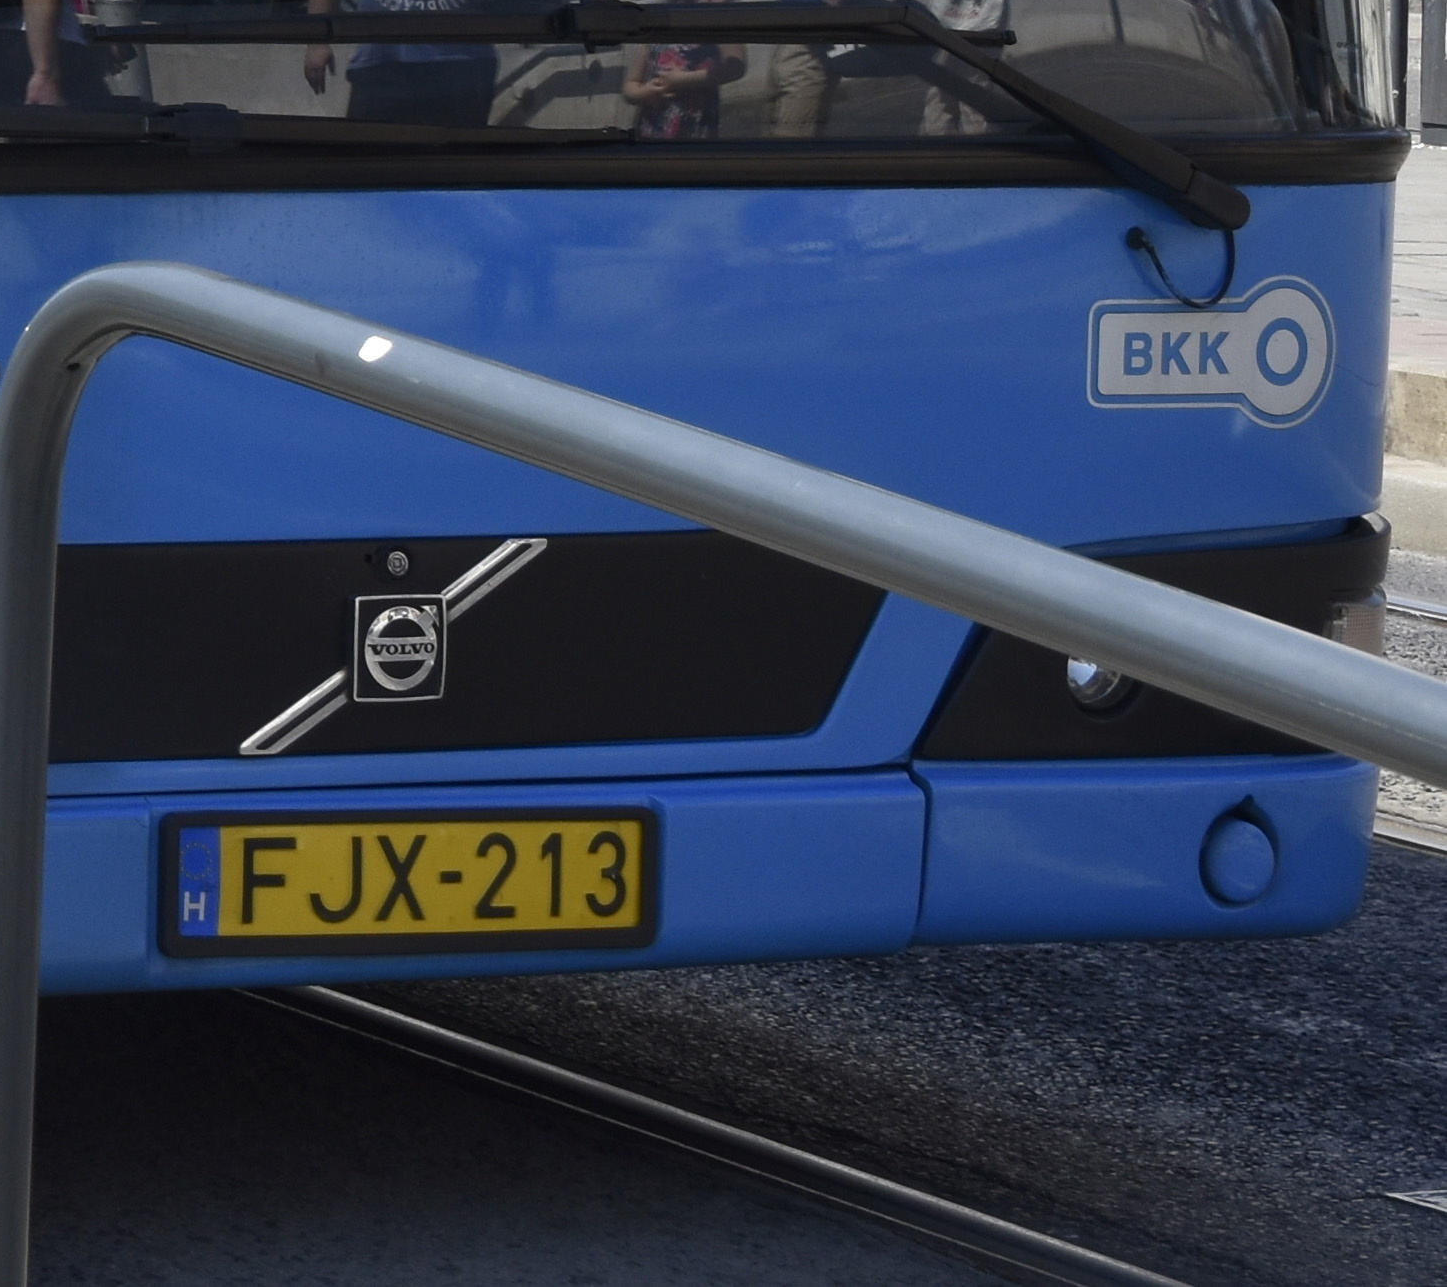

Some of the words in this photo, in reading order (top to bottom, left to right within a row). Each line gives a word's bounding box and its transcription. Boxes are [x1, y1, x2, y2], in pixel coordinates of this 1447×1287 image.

[1122, 330, 1231, 377] BKK
[367, 641, 436, 657] VOLVO
[240, 830, 628, 926] FJX-213
[182, 891, 206, 923] H
